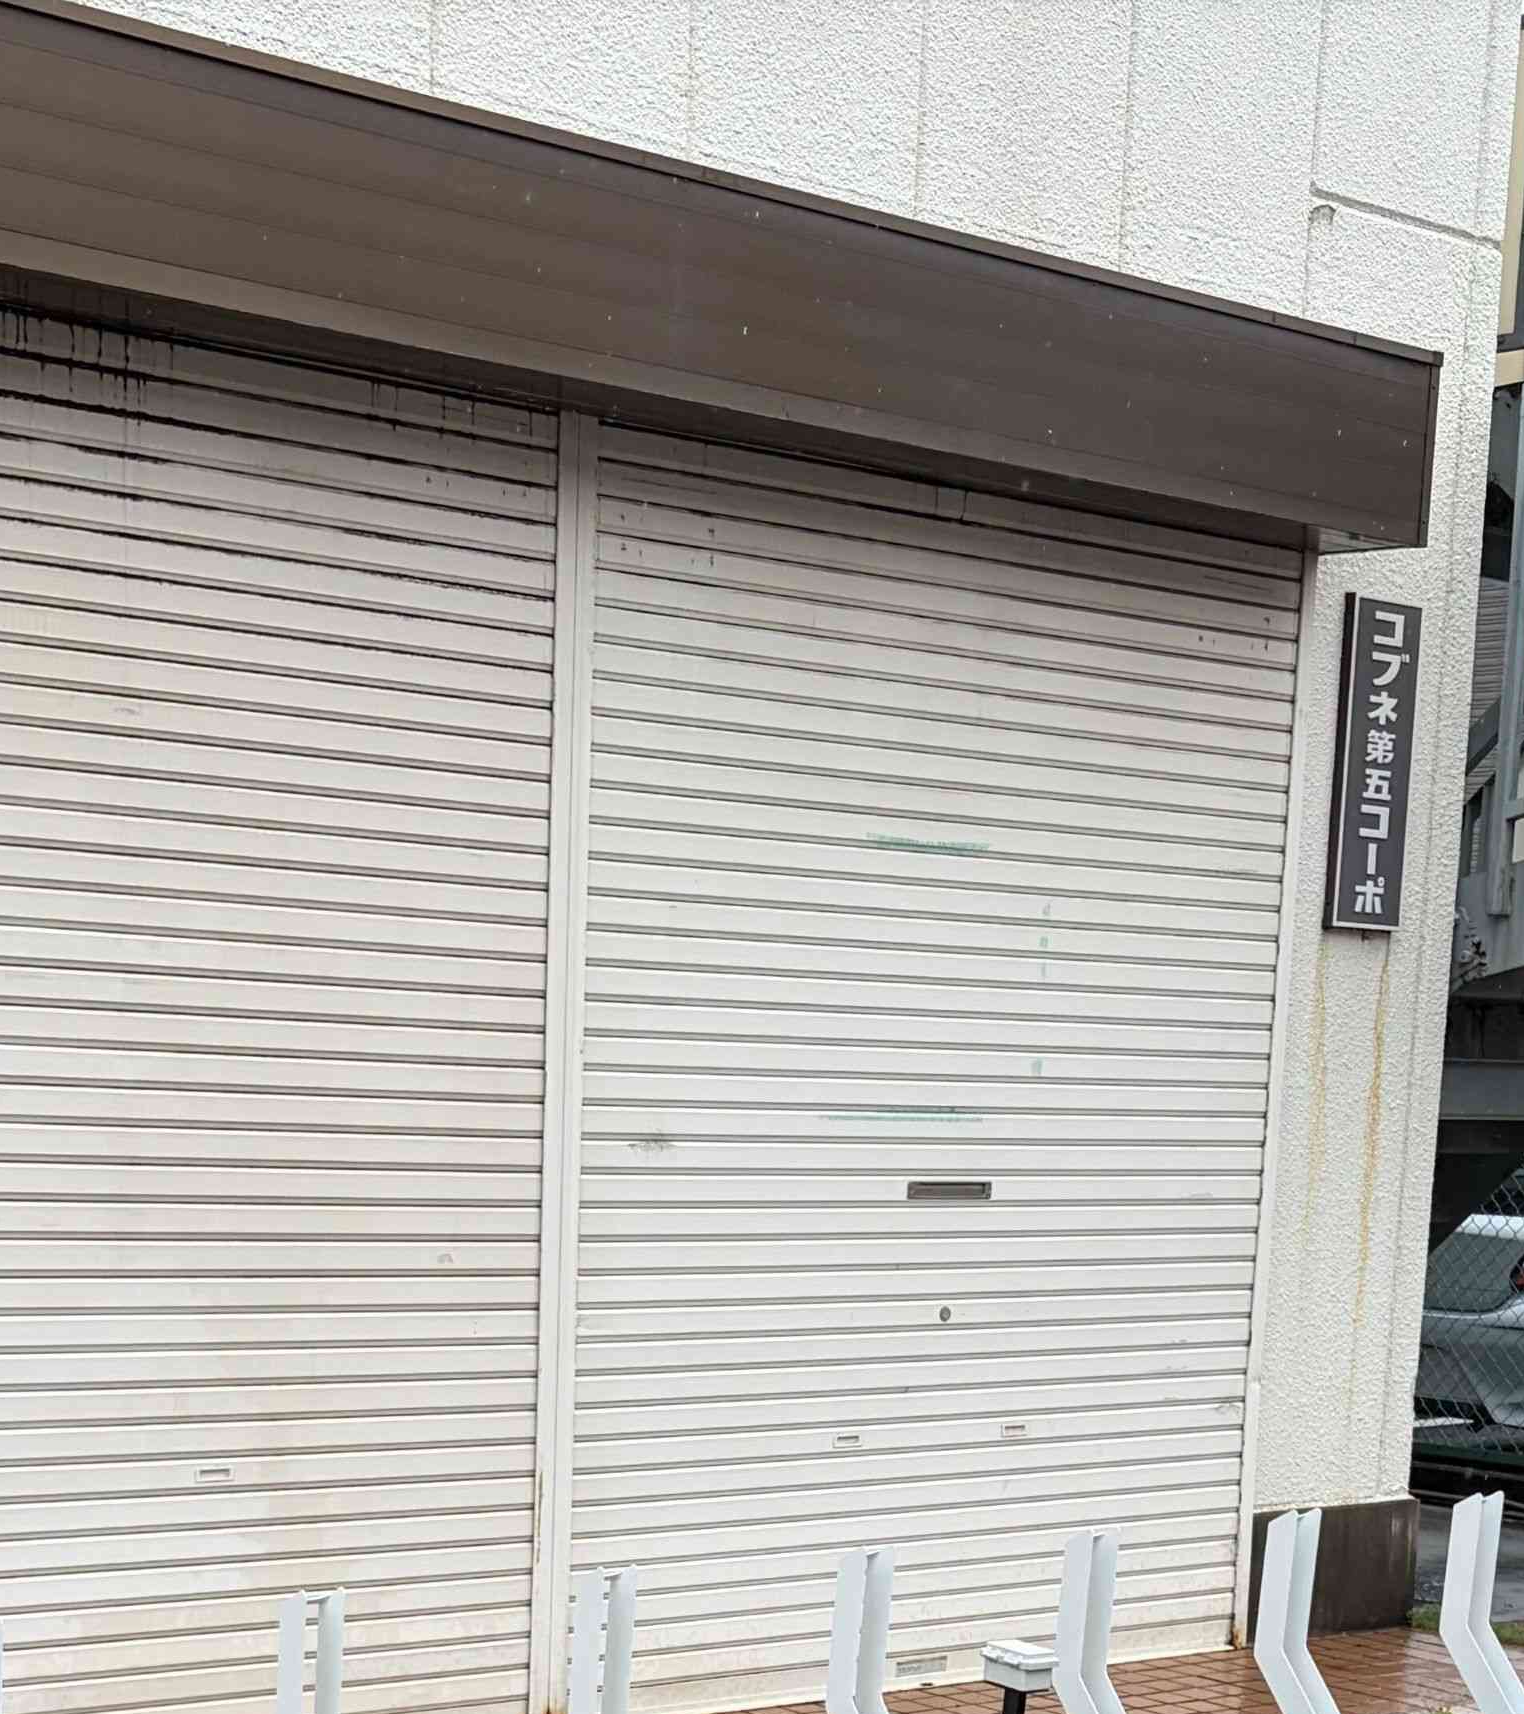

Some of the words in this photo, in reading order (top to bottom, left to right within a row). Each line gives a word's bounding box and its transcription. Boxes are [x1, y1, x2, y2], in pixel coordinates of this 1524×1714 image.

[1353, 609, 1411, 916] コブネ第五コーポ
